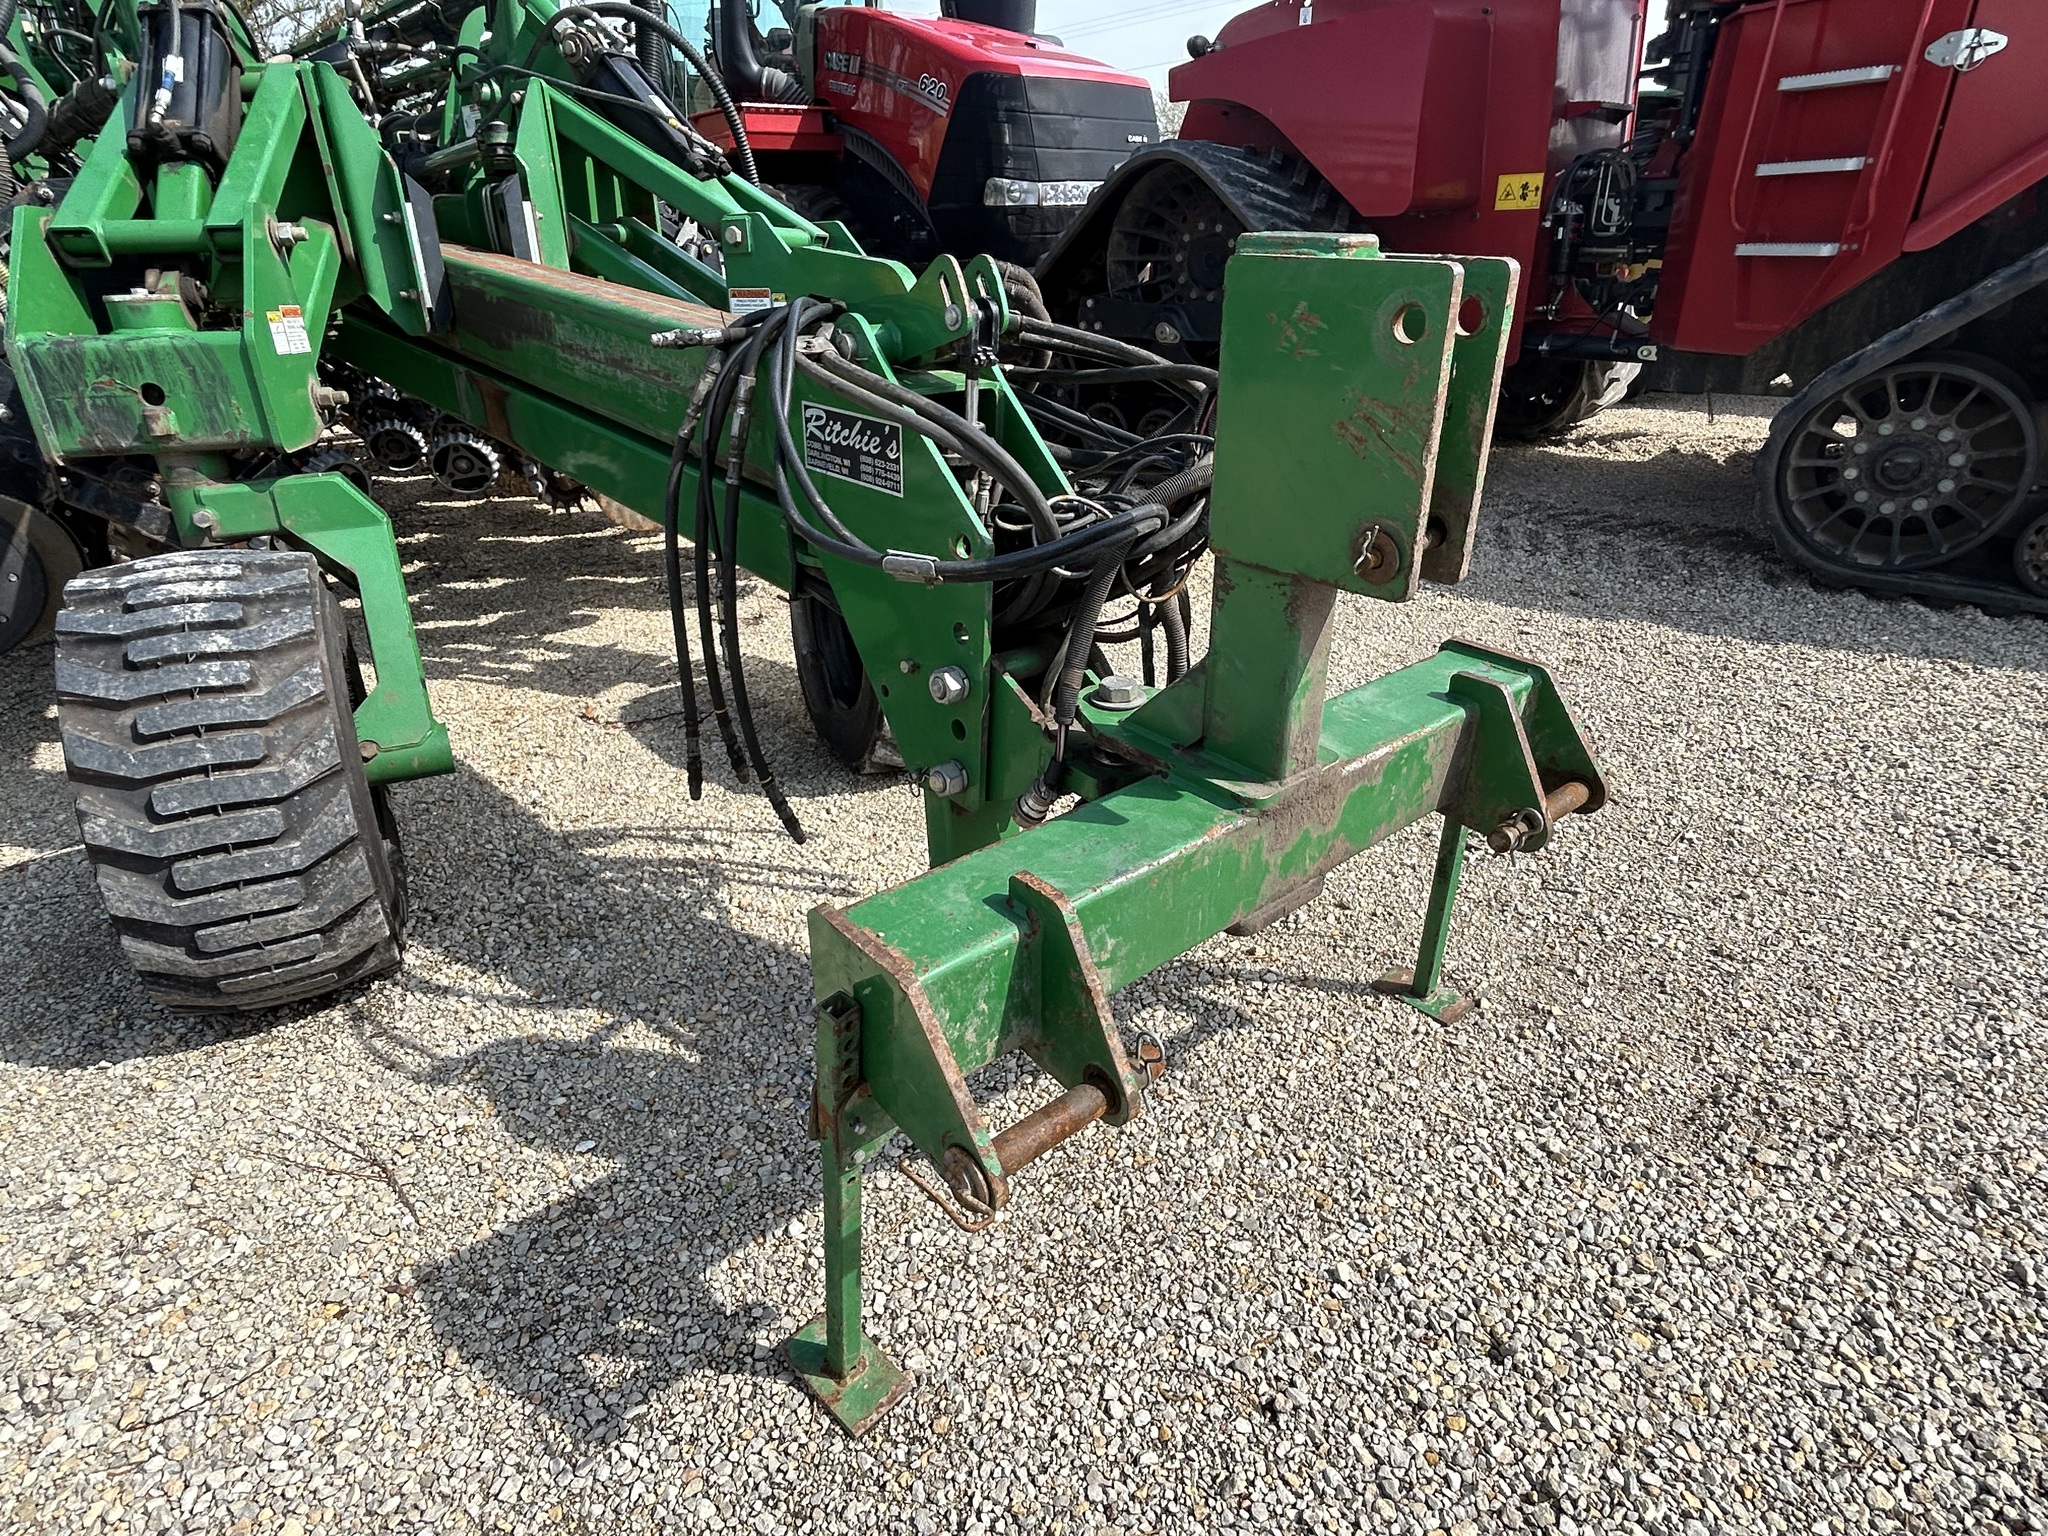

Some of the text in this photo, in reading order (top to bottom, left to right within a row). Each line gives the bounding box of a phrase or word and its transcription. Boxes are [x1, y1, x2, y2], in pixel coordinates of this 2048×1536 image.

[824, 50, 850, 73] CASE
[918, 73, 947, 101] 620
[805, 407, 900, 459] Ritchie's
